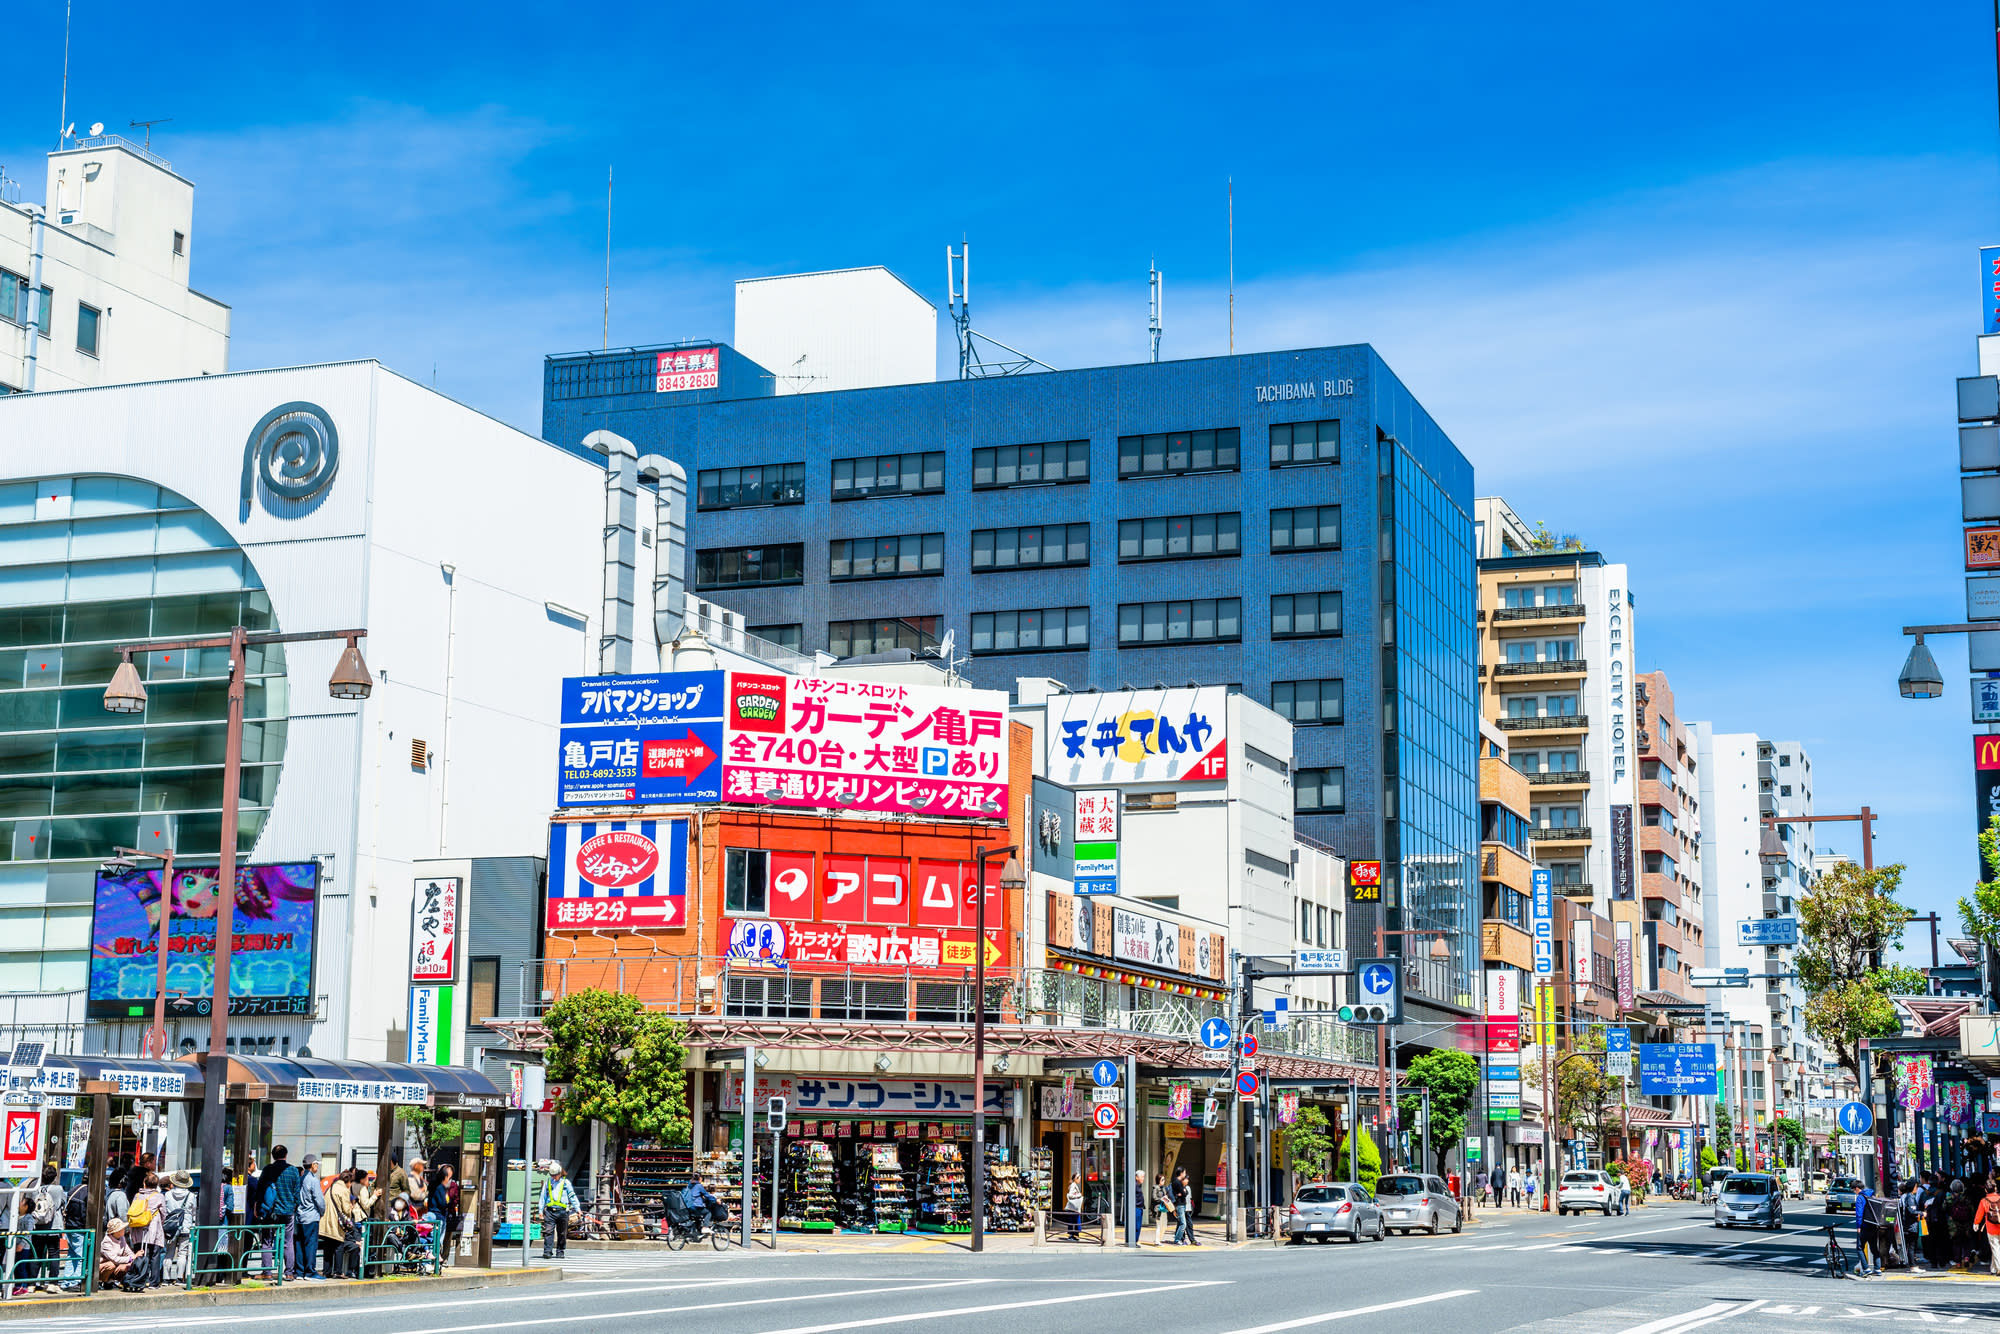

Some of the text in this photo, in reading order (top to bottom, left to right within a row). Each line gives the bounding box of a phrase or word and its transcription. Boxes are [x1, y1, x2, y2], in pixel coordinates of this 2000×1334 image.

[660, 354, 715, 373] 広告募集
[1256, 379, 1353, 402] TACHIBANA BLDG
[581, 678, 659, 688] Dramatic Communication
[736, 681, 781, 691] パチンコ・スロット
[794, 678, 908, 700] パチンコ・スロット
[1609, 589, 1625, 781] EXCEL CITY HOTEL
[580, 684, 704, 714] アパマンショップ
[736, 694, 781, 711] GARDEN
[1980, 682, 1998, 710] 不動産
[739, 707, 778, 722] GARDEN
[791, 696, 1003, 747] ガーデン亀戸
[564, 738, 640, 768] 亀戸店
[648, 747, 704, 759] 道路向かい側
[648, 758, 684, 769] ビル4階
[1200, 758, 1224, 776] 1F
[728, 769, 1004, 812] 浅草通りオリンピック近く
[581, 834, 656, 856] COFFEE & RESTAURANT
[1076, 862, 1114, 873] FamilyMart
[826, 871, 954, 908] アコム
[1078, 882, 1112, 892] 酒 たばこ
[1536, 872, 1548, 916] 中高受験
[557, 901, 627, 922] 徒歩2分
[789, 930, 845, 948] カラオケ
[1742, 923, 1790, 934] 亀戸駅北口
[796, 948, 836, 962] ルーム
[846, 934, 939, 967] 歌広場
[1300, 953, 1340, 962] 亀戸駅北口
[1536, 922, 1551, 973] ena
[417, 990, 430, 1063] FamilyMart
[1264, 1024, 1288, 1032] 時差式
[1906, 1063, 1920, 1109] 藤まつり
[1950, 1086, 1960, 1122] 藤まつり
